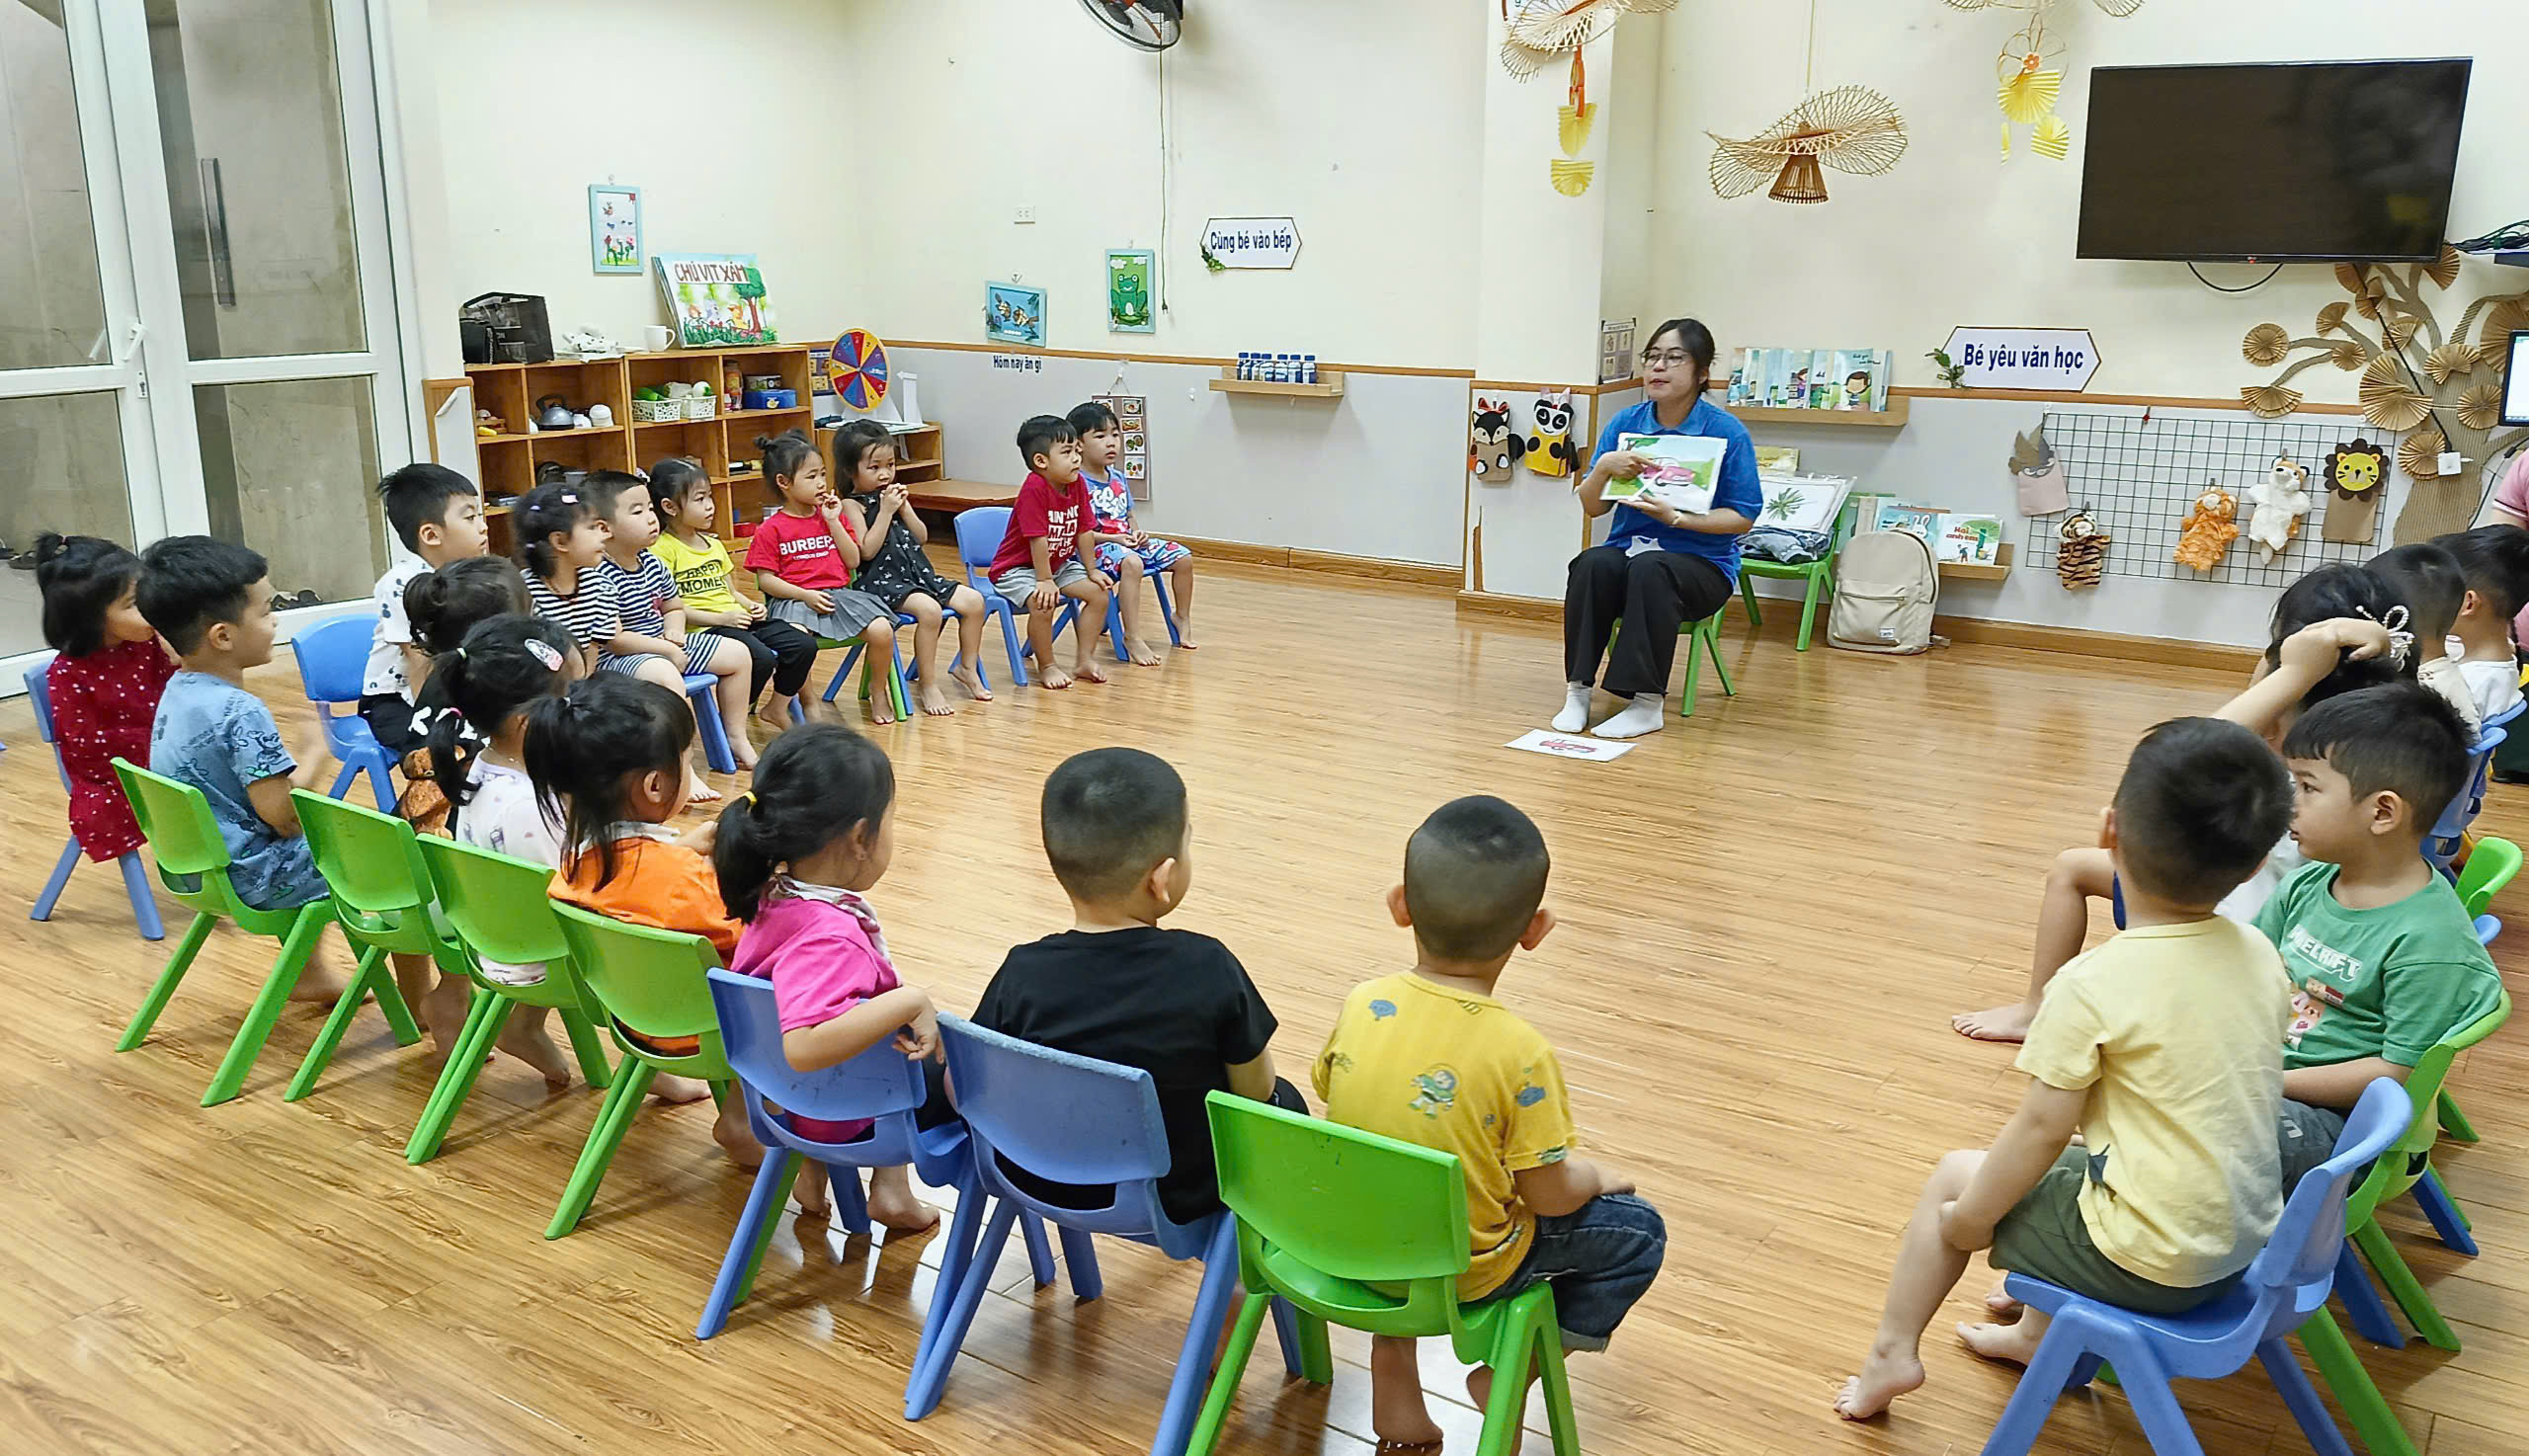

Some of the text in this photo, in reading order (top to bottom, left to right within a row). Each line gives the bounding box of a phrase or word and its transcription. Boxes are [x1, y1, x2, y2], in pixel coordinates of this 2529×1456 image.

[1210, 226, 1292, 254] Cùng bé vào bếp
[674, 261, 700, 283] CHÚ
[993, 355, 1010, 368] Hôm
[1011, 359, 1023, 373] nay
[1964, 343, 2084, 375] Bé yêu văn học
